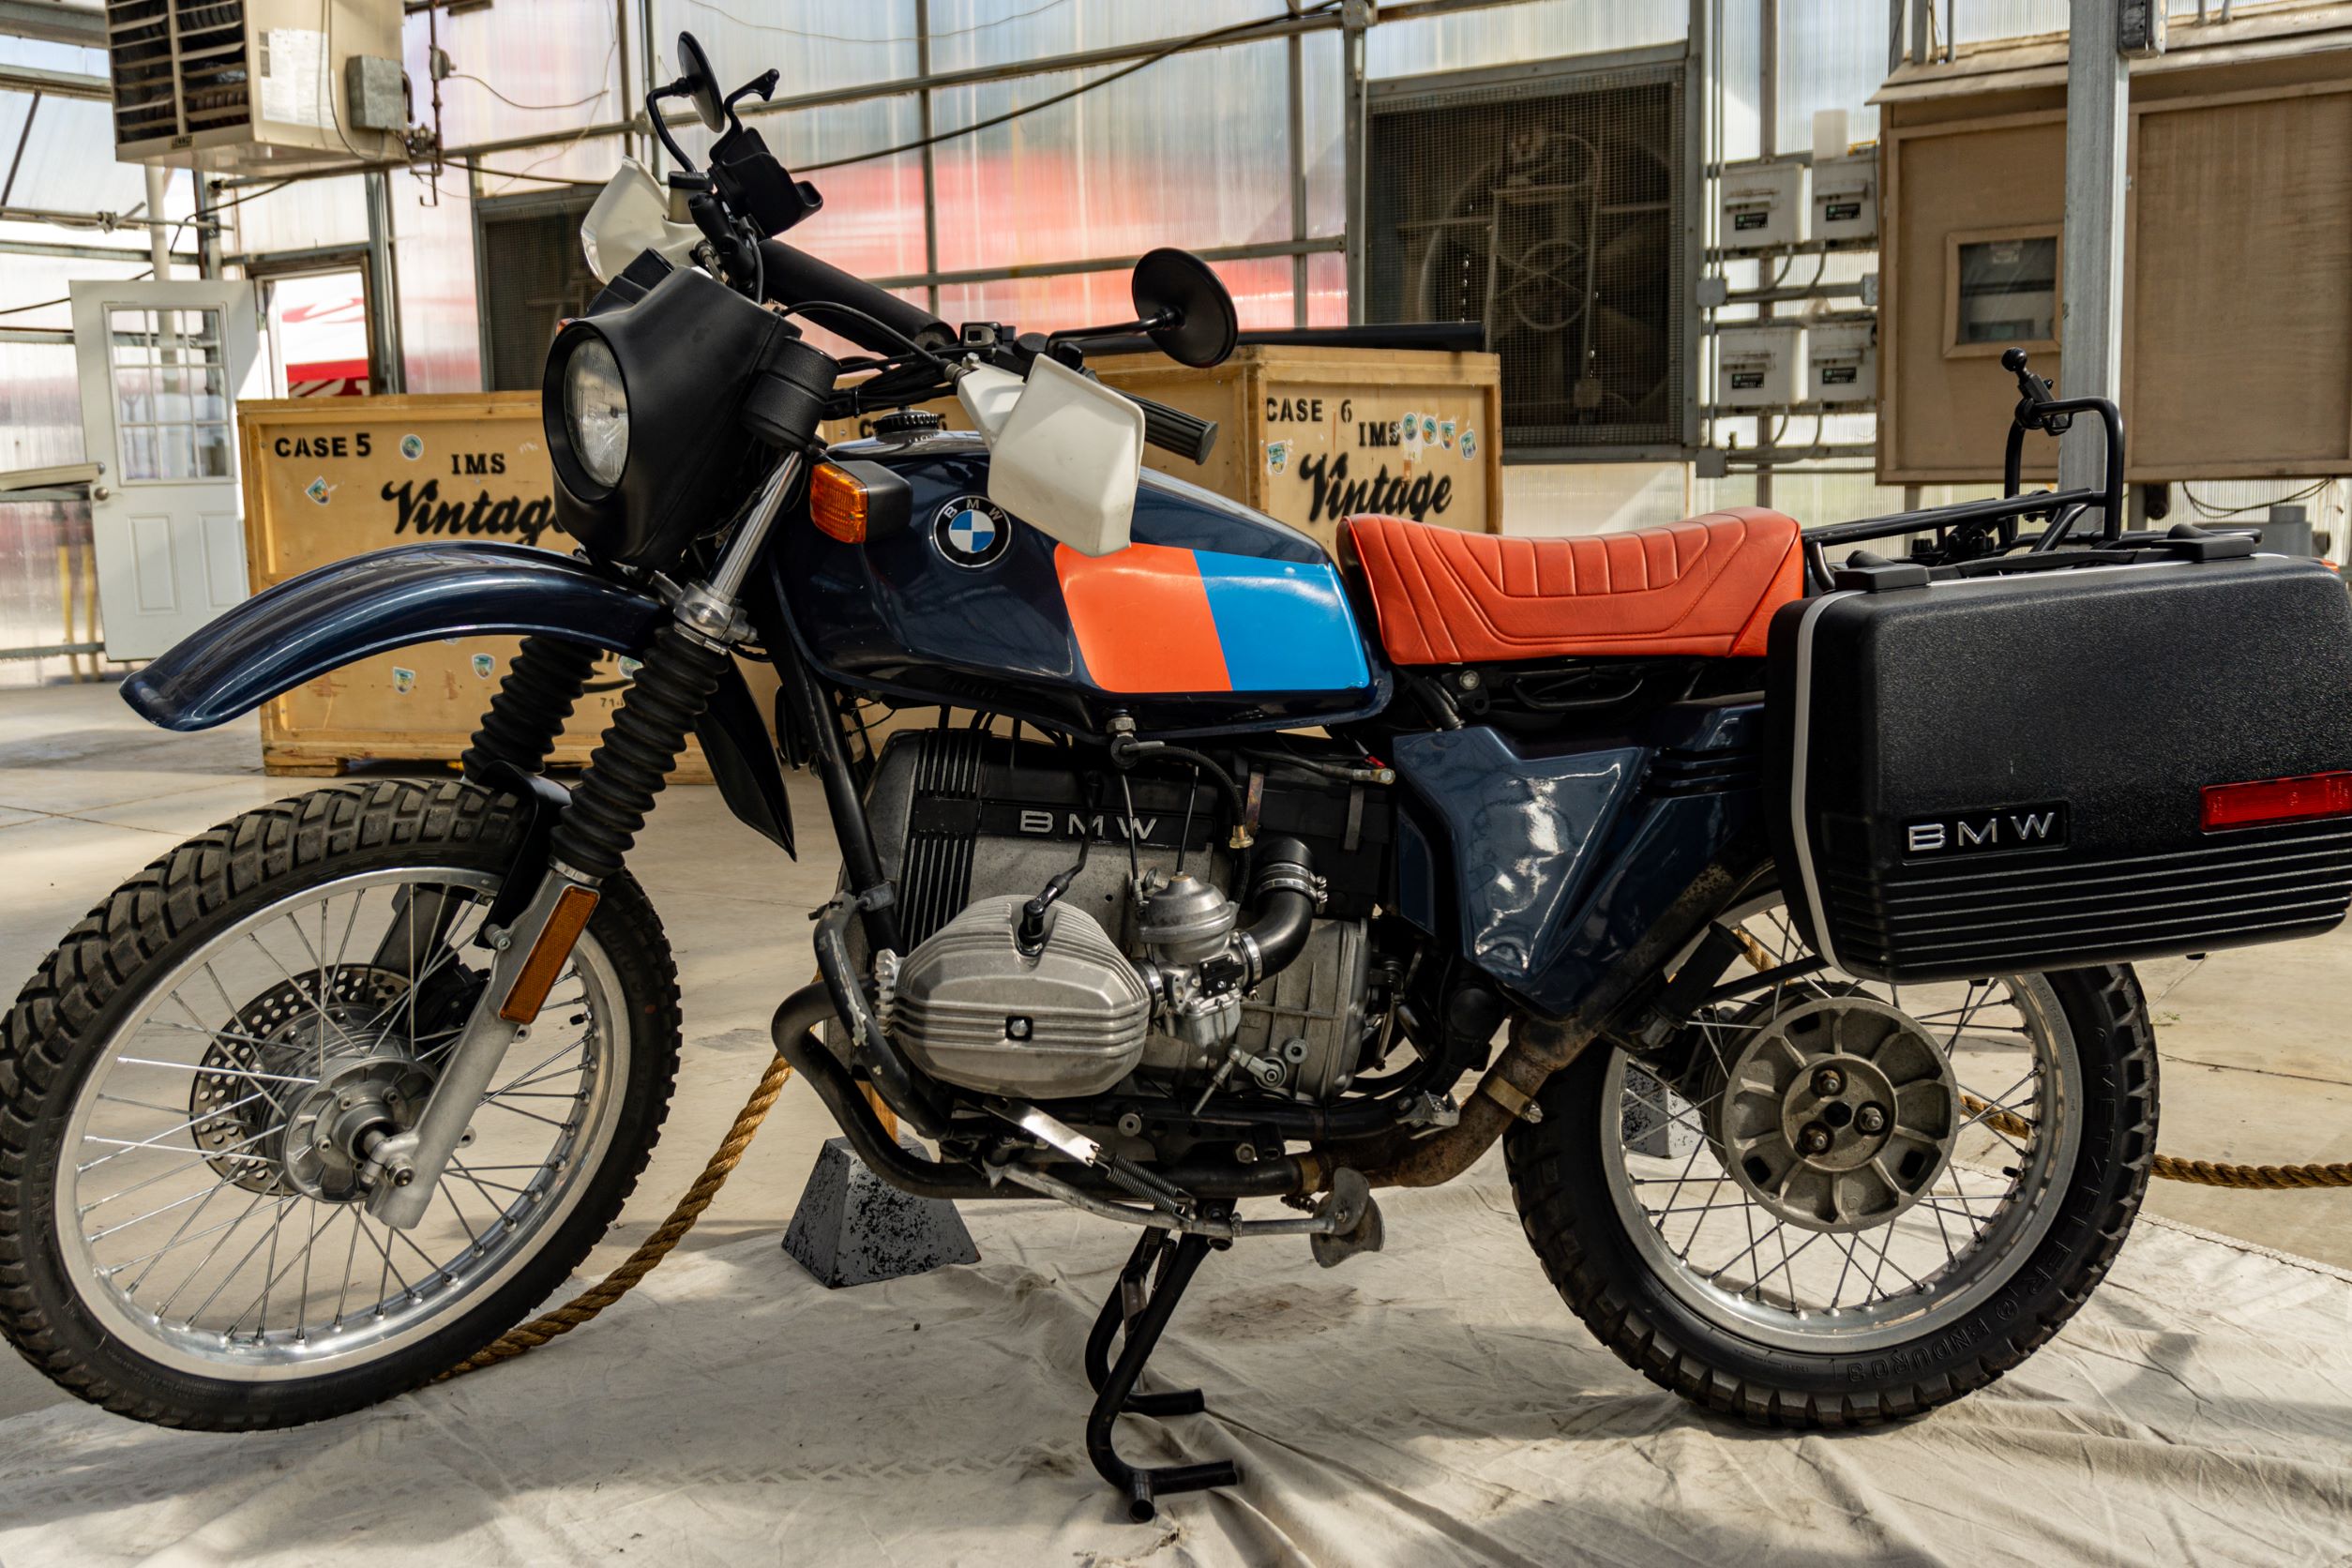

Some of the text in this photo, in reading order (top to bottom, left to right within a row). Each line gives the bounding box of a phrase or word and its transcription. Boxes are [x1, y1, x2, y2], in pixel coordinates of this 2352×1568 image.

[1266, 398, 1352, 423] CASE 6
[274, 432, 371, 458] CASE 5
[1358, 422, 1401, 446] IMS
[451, 453, 506, 475] IMS
[1298, 451, 1453, 522] Vintage
[943, 498, 1003, 521] BMW
[1019, 809, 1157, 840] BMW
[1908, 812, 2055, 852] BMW
